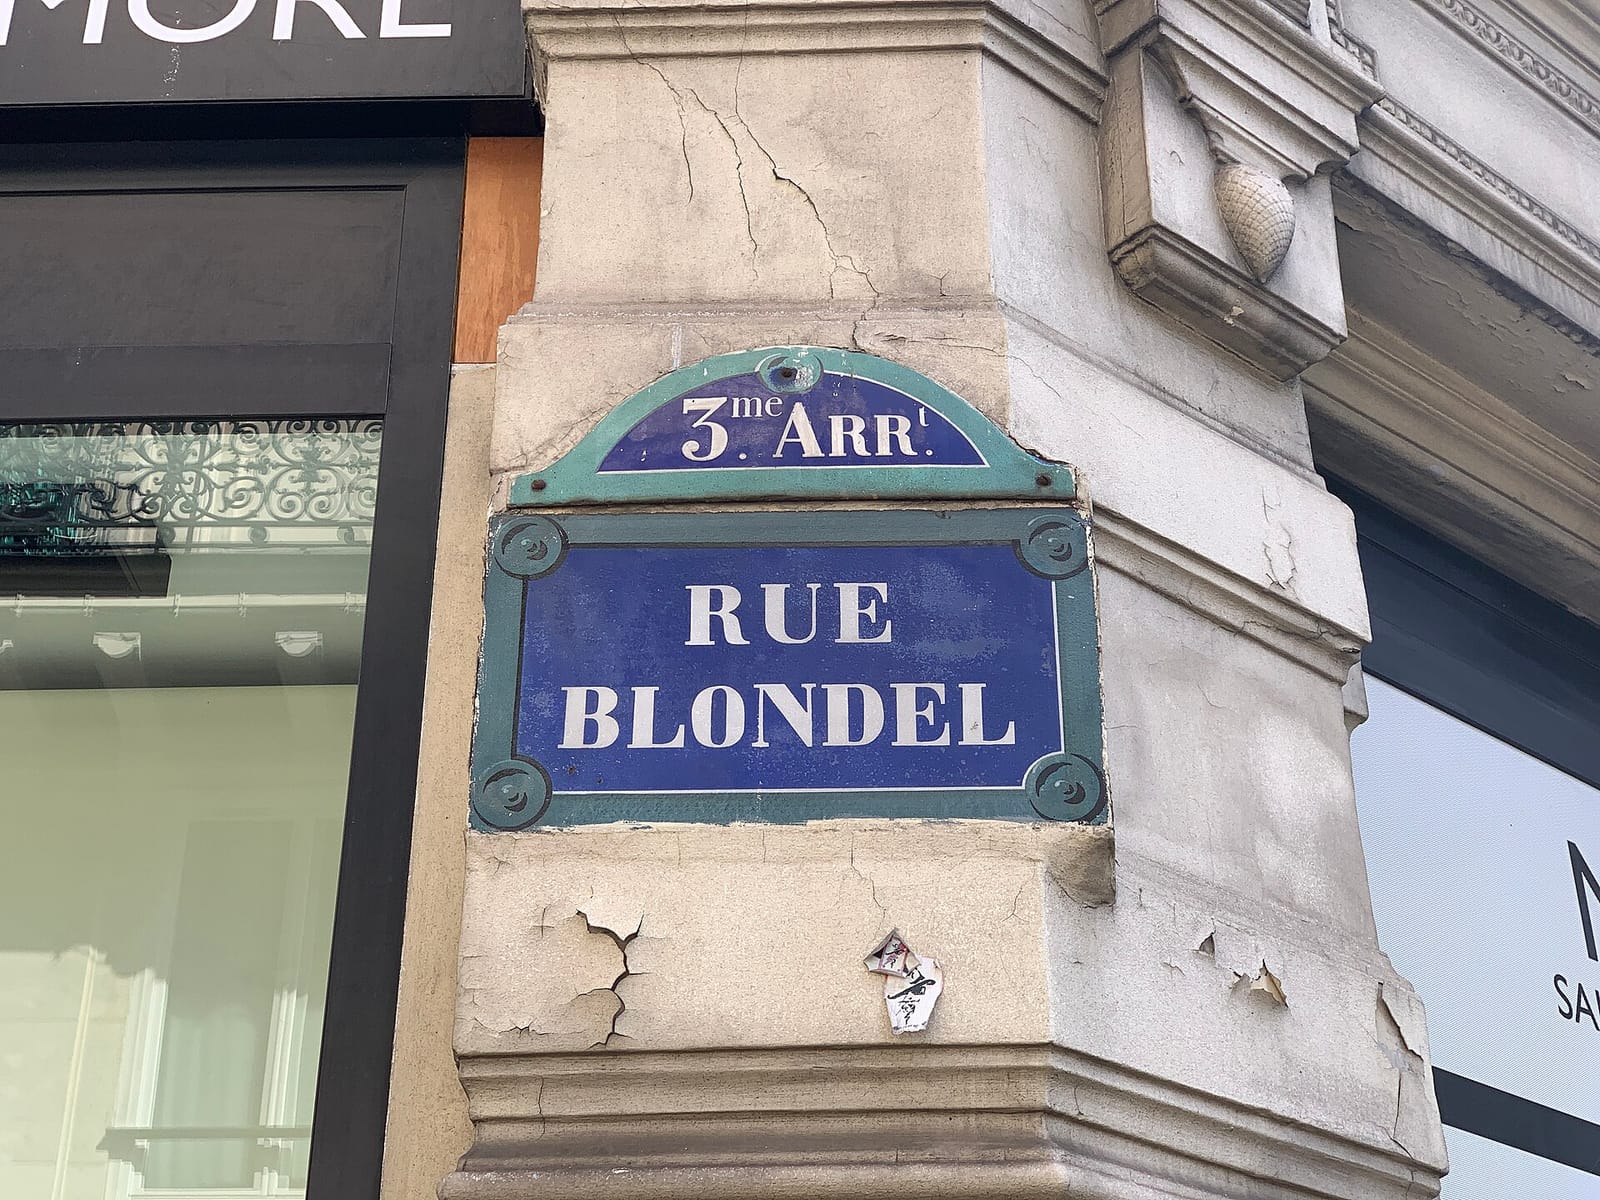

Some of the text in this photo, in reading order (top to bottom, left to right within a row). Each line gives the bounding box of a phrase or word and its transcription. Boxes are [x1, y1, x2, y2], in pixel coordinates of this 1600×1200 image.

[685, 582, 892, 646] RUE
[557, 683, 1016, 749] BLONDEL
[1553, 974, 1600, 1032] SA
